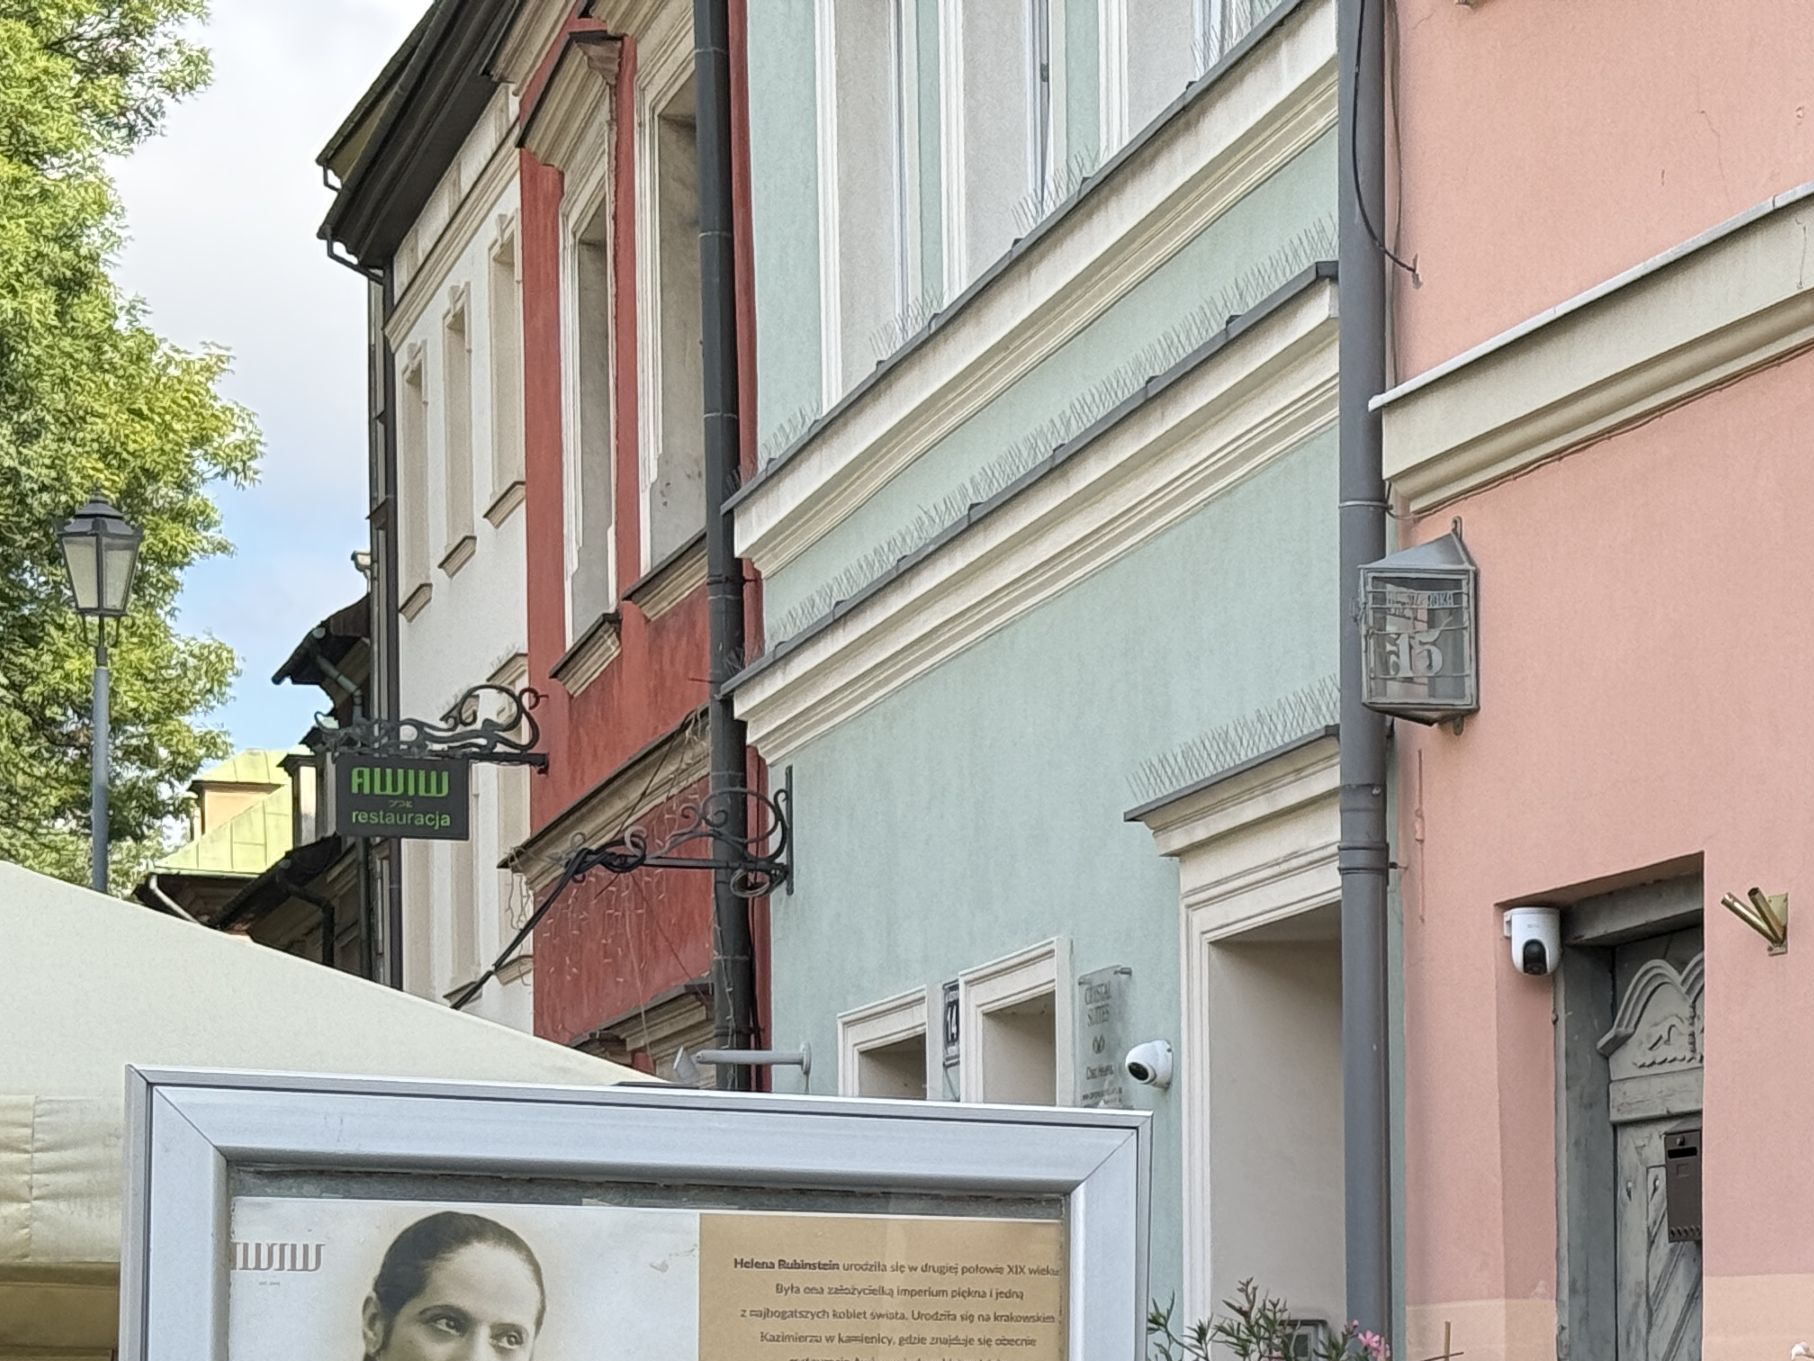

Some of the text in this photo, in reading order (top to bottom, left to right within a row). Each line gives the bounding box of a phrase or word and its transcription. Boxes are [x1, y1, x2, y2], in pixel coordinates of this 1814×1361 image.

[352, 767, 449, 797] AWIW
[352, 810, 451, 830] restauracja
[733, 1258, 776, 1269] Helena
[777, 1259, 841, 1270] Rubinstein
[842, 1261, 888, 1272] urodziła
[920, 1263, 959, 1275] drugiej
[960, 1264, 1005, 1275] połowie
[1006, 1265, 1026, 1275] XIX
[775, 1283, 801, 1296] Była
[896, 1287, 949, 1298] imperium
[950, 1288, 988, 1299] piękna
[994, 1289, 1025, 1300] jedną
[831, 1309, 868, 1319] kobiet
[977, 1314, 992, 1322] na
[759, 1332, 823, 1343] Kazimierzu
[897, 1334, 928, 1346] gdzie
